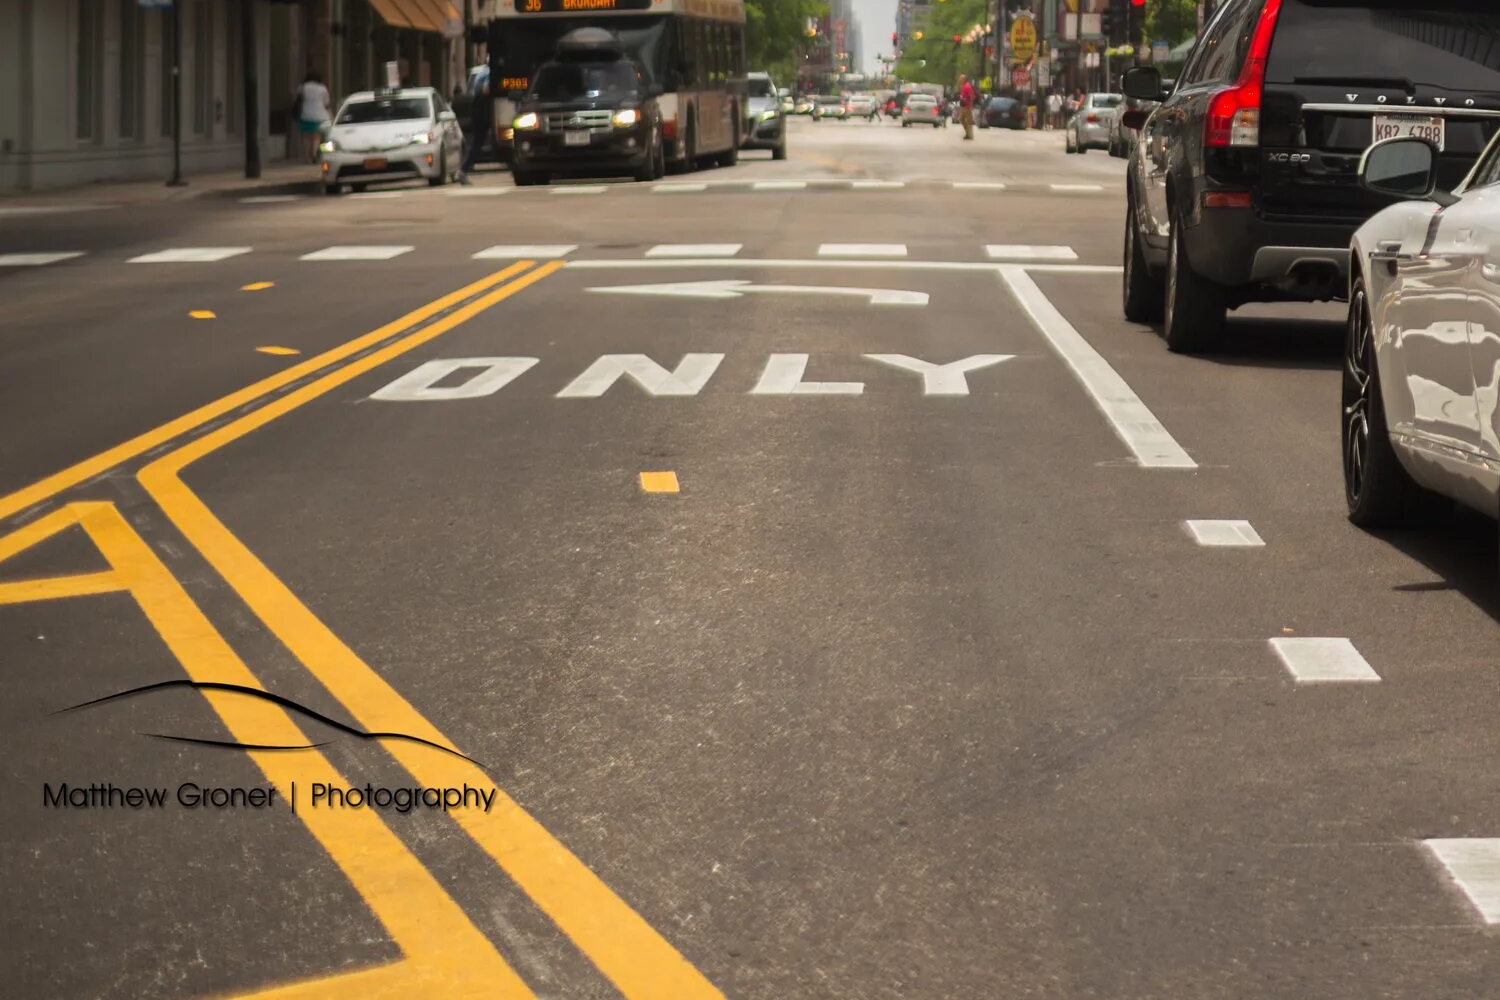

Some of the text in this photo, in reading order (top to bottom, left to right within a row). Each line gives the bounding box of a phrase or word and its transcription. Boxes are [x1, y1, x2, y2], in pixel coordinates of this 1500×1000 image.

[1346, 93, 1475, 106] VOLVO
[1376, 124, 1441, 144] K82 6788
[368, 353, 1018, 400] ONLY
